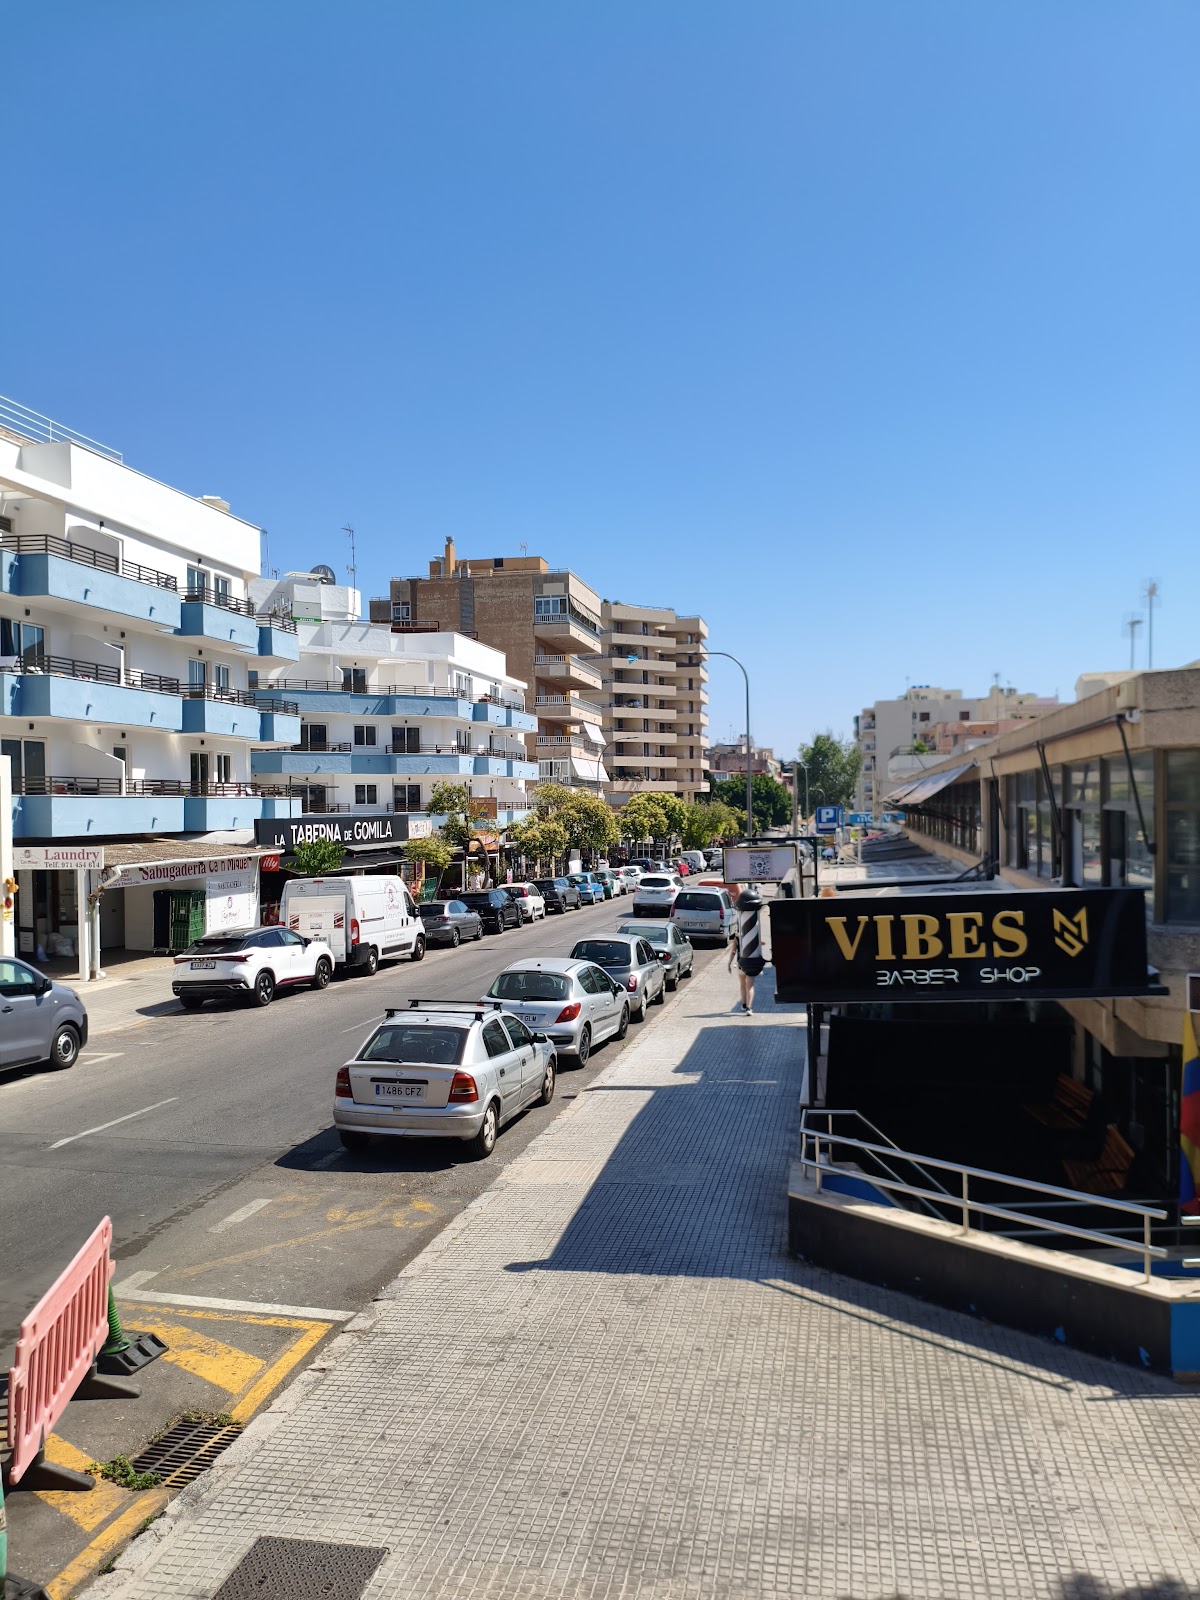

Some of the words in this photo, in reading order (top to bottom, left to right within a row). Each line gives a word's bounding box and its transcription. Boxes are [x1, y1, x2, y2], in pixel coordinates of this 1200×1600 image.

[821, 809, 834, 822] P
[274, 834, 286, 846] LA
[290, 823, 342, 844] TABERNA
[343, 830, 353, 841] DE
[353, 820, 393, 840] GOMILA
[44, 848, 100, 863] Laundry
[262, 857, 279, 870] illy
[824, 910, 1029, 961] VIBES
[875, 968, 960, 985] BARBER
[979, 966, 1042, 983] SHOP
[382, 1086, 403, 1096] 1486
[405, 1087, 422, 1097] CFZ
